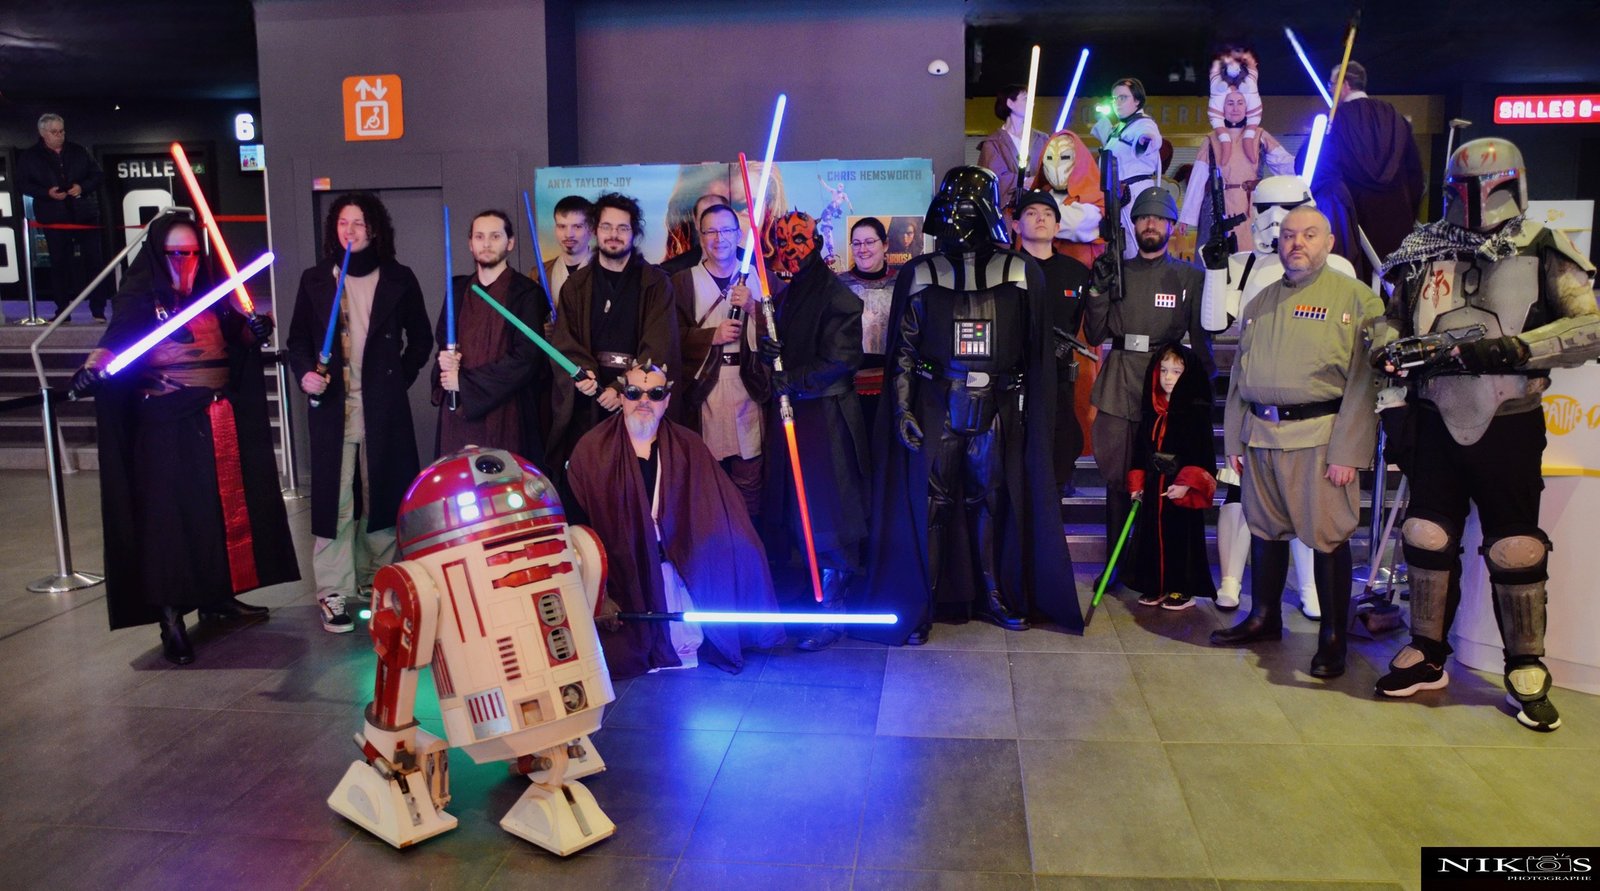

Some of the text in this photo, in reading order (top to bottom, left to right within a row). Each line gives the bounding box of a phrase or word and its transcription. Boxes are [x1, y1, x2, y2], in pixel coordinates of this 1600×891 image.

[1499, 100, 1575, 118] SALLES
[235, 113, 254, 141] 6
[117, 161, 175, 179] SALLE
[827, 169, 922, 181] CHRIS HEMSWORTH
[548, 176, 631, 189] ANYA TAYLOR-JOY
